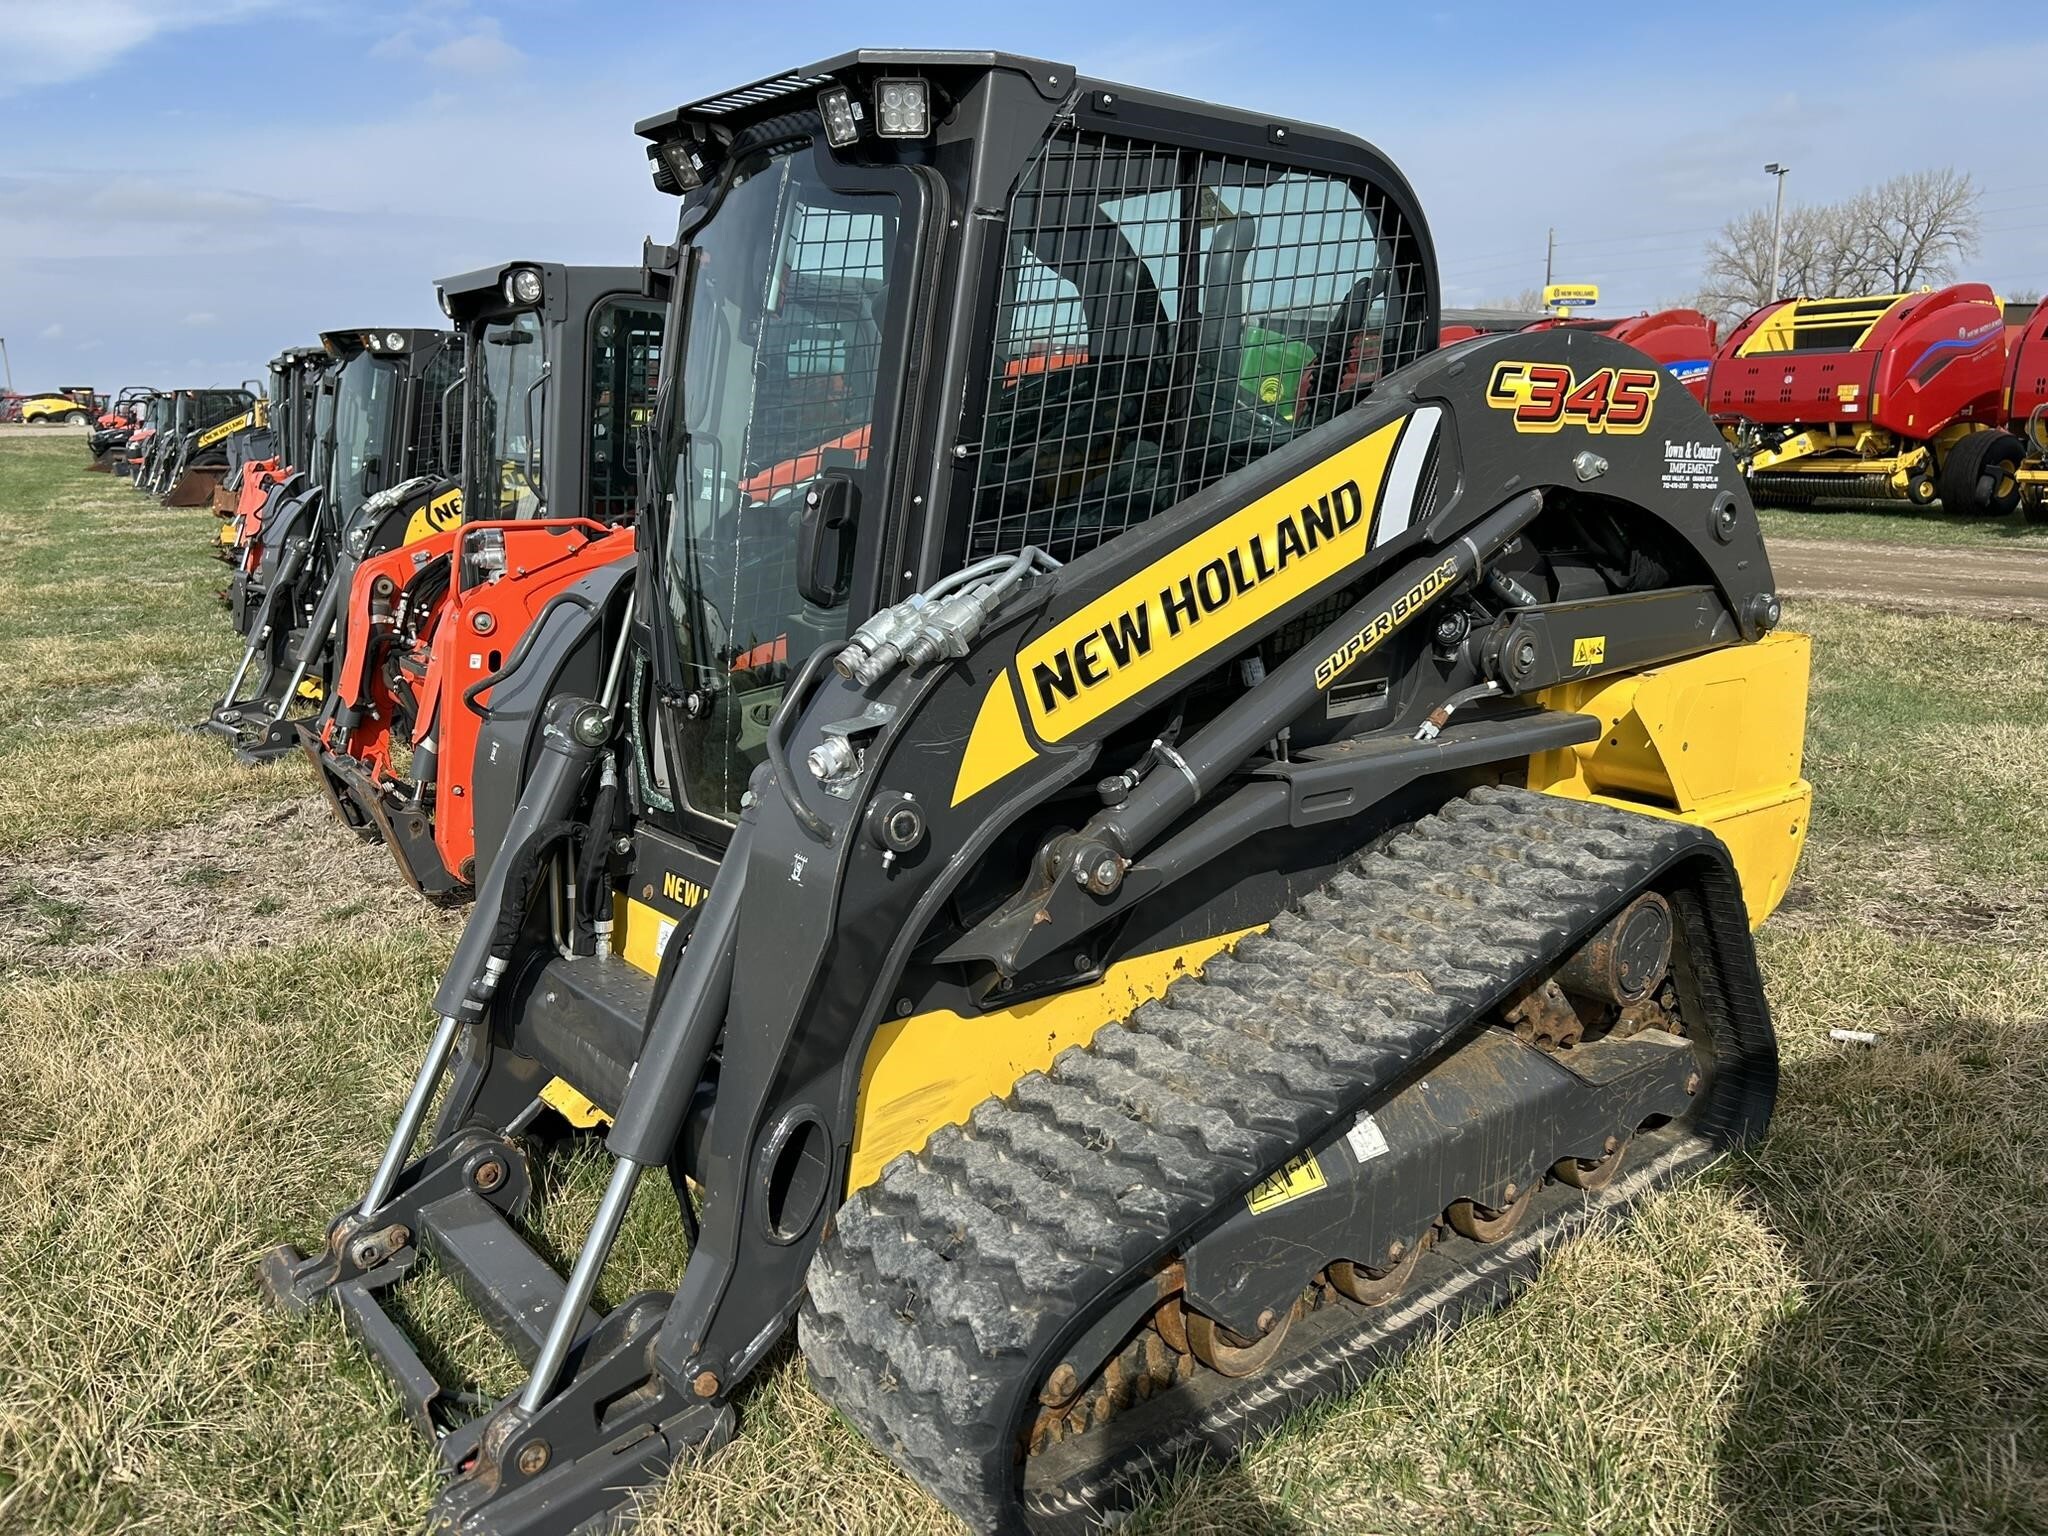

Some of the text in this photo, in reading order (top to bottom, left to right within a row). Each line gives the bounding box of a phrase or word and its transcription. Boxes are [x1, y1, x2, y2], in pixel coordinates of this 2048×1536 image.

[1487, 361, 1660, 434] C345
[1664, 440, 1722, 464] Town & Country
[1669, 463, 1714, 474] IMPLEMENT
[434, 498, 463, 523] NE
[1031, 479, 1364, 715] NEW HOLLAND
[1314, 611, 1393, 692] SUPER
[663, 871, 701, 908] NEW
